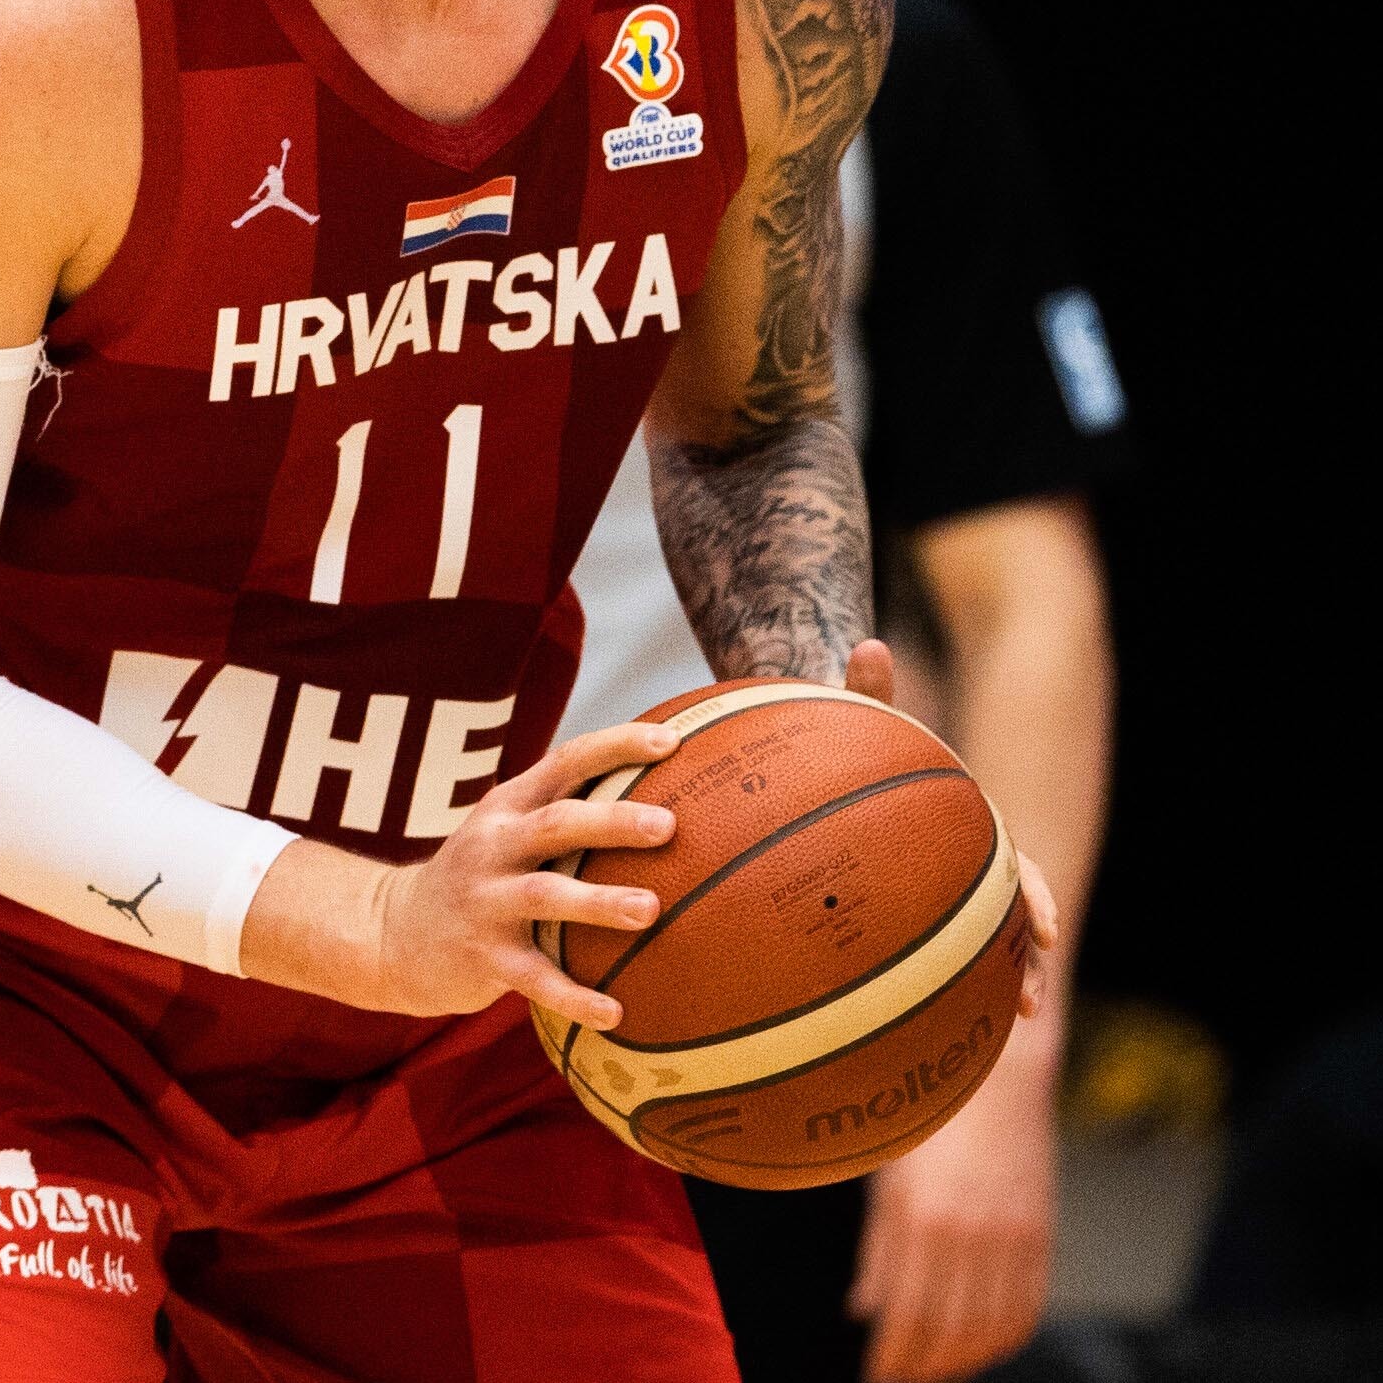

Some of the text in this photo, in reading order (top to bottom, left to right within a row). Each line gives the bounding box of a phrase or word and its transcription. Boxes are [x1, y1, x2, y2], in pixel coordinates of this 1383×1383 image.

[610, 127, 696, 153] WORLD CUP
[611, 142, 697, 166] QUALIFIERS
[208, 233, 681, 402] HRVATSKA
[309, 403, 483, 605] 11
[682, 753, 741, 795] OFFICIAL
[740, 732, 782, 756] GAME
[805, 1014, 993, 1142] molten
